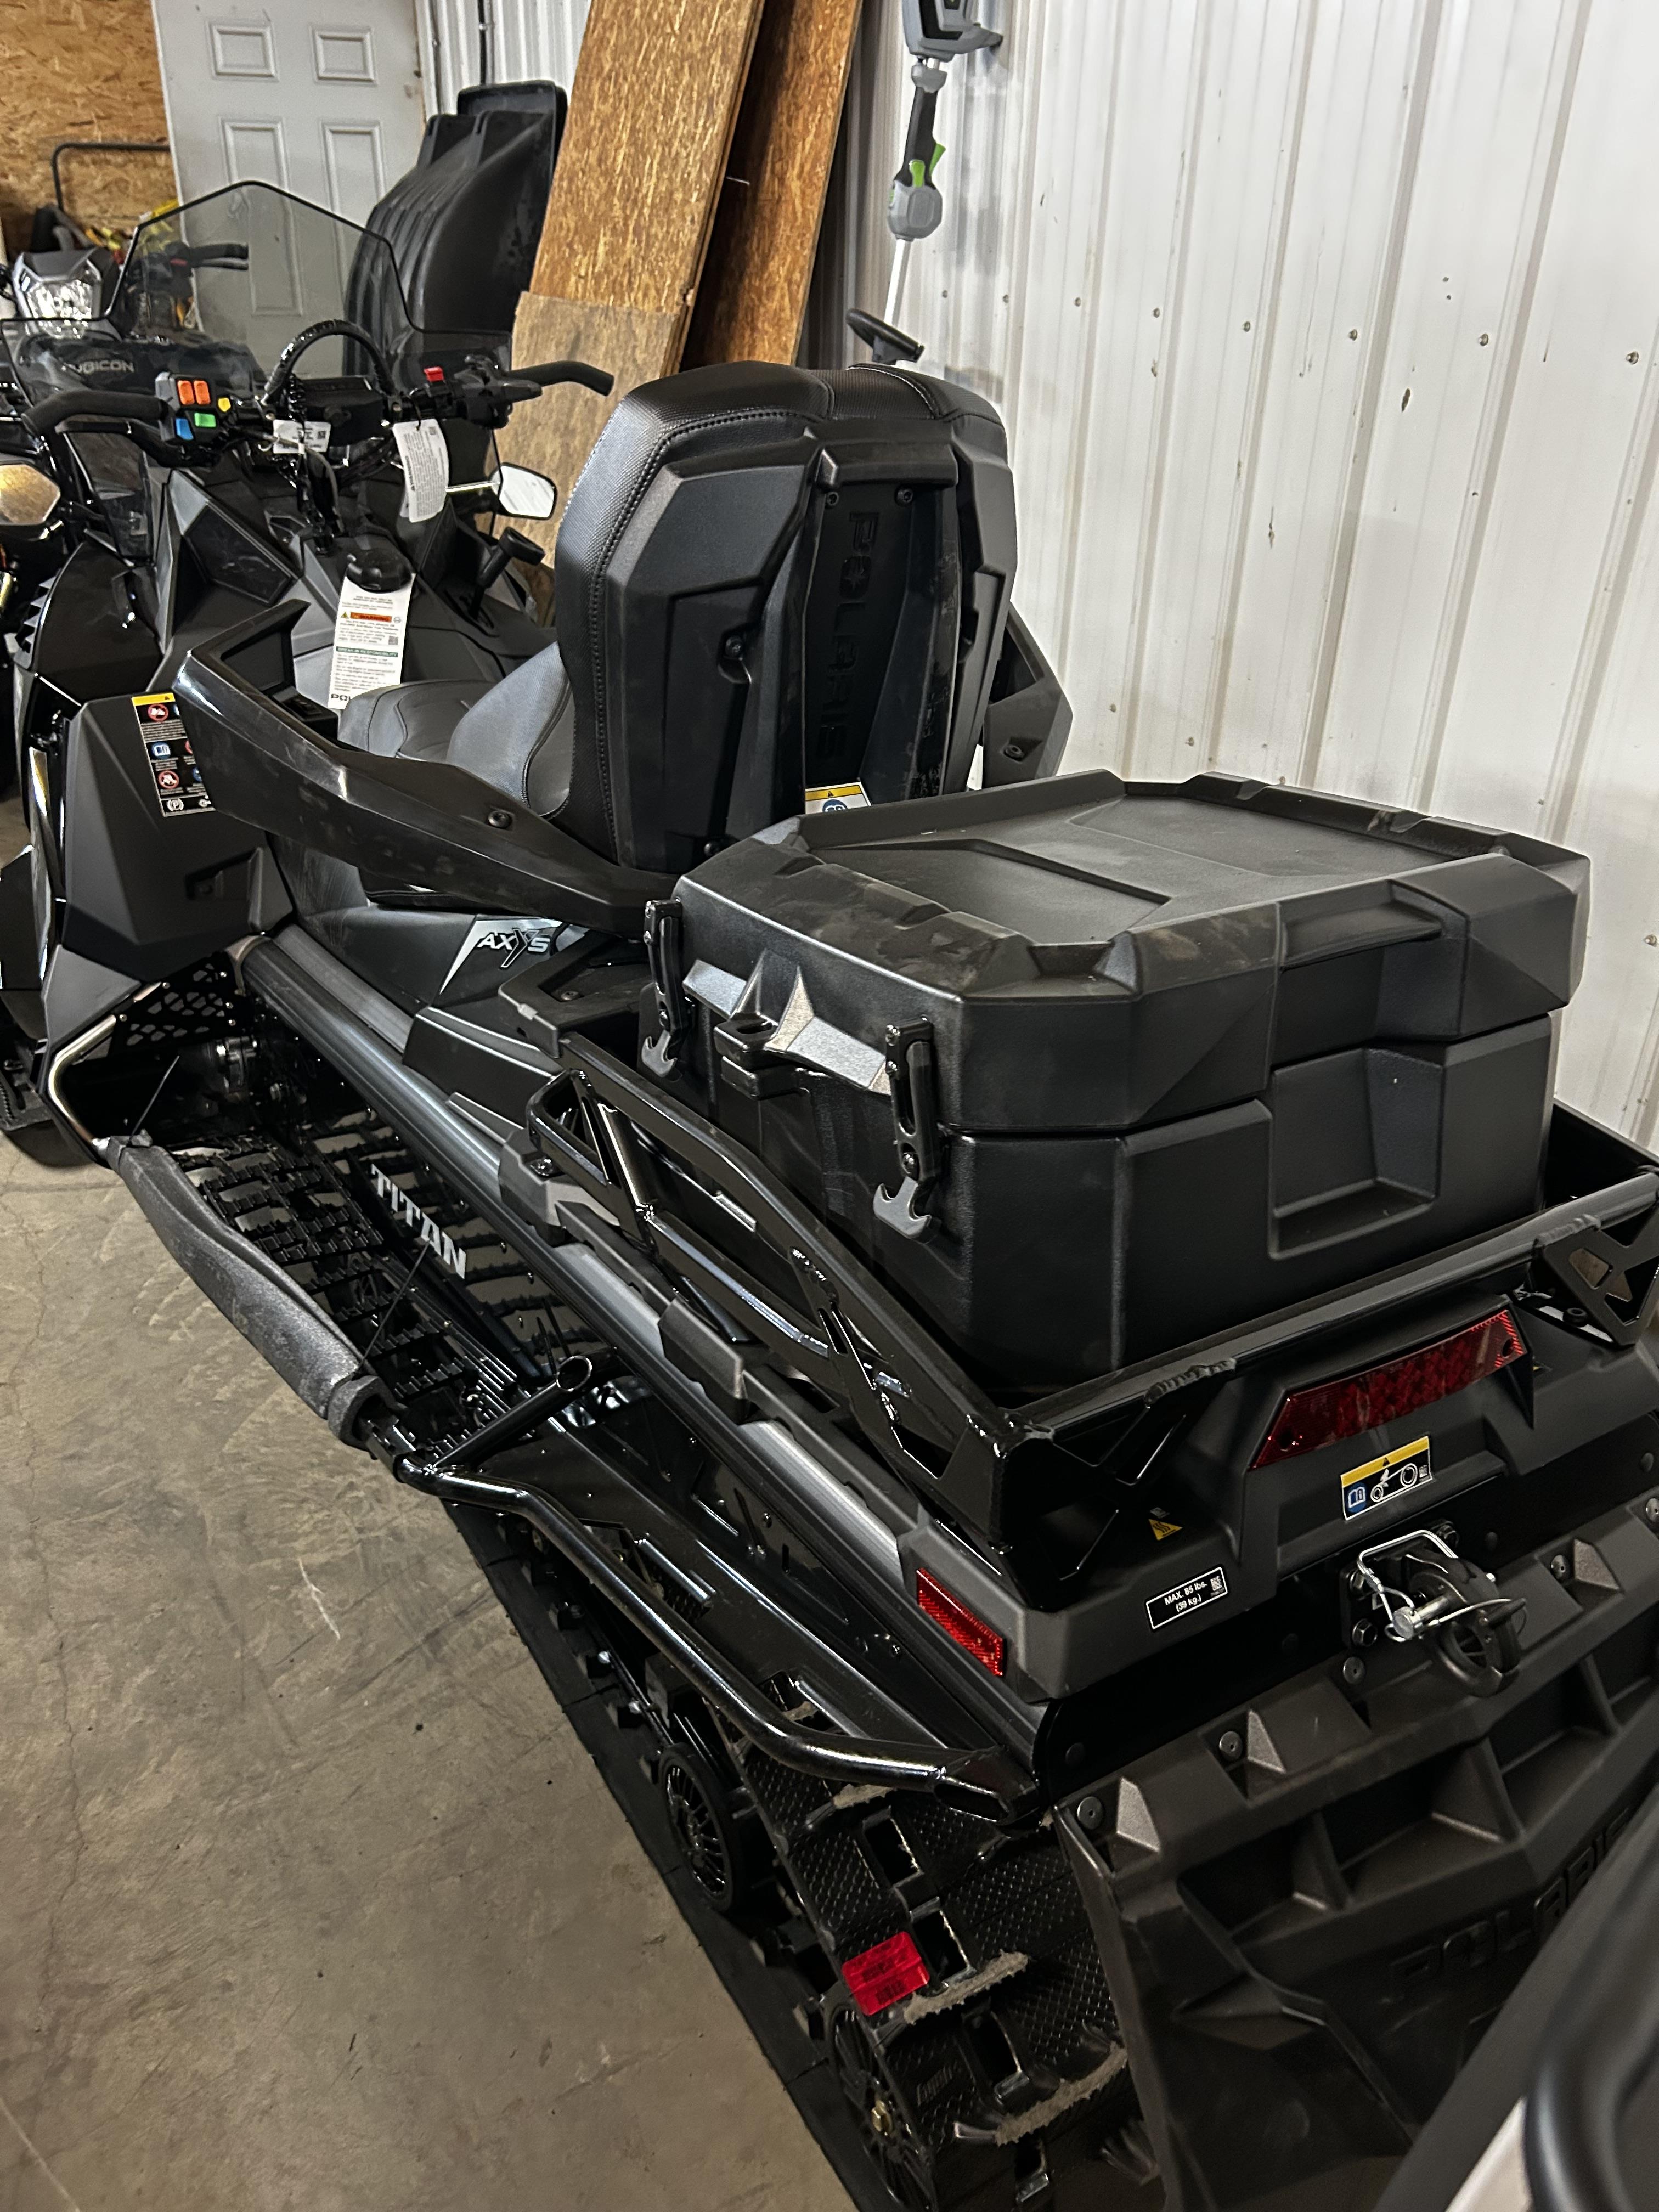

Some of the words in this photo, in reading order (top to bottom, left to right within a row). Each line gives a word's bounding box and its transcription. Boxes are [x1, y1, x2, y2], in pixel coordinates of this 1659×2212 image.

[65, 359, 135, 374] UBICON
[817, 512, 879, 760] POLARIS
[371, 1163, 467, 1279] TITAN
[1164, 1590, 1184, 1605] MAX.
[1184, 1585, 1194, 1595] 85
[1176, 1600, 1187, 1612] (39
